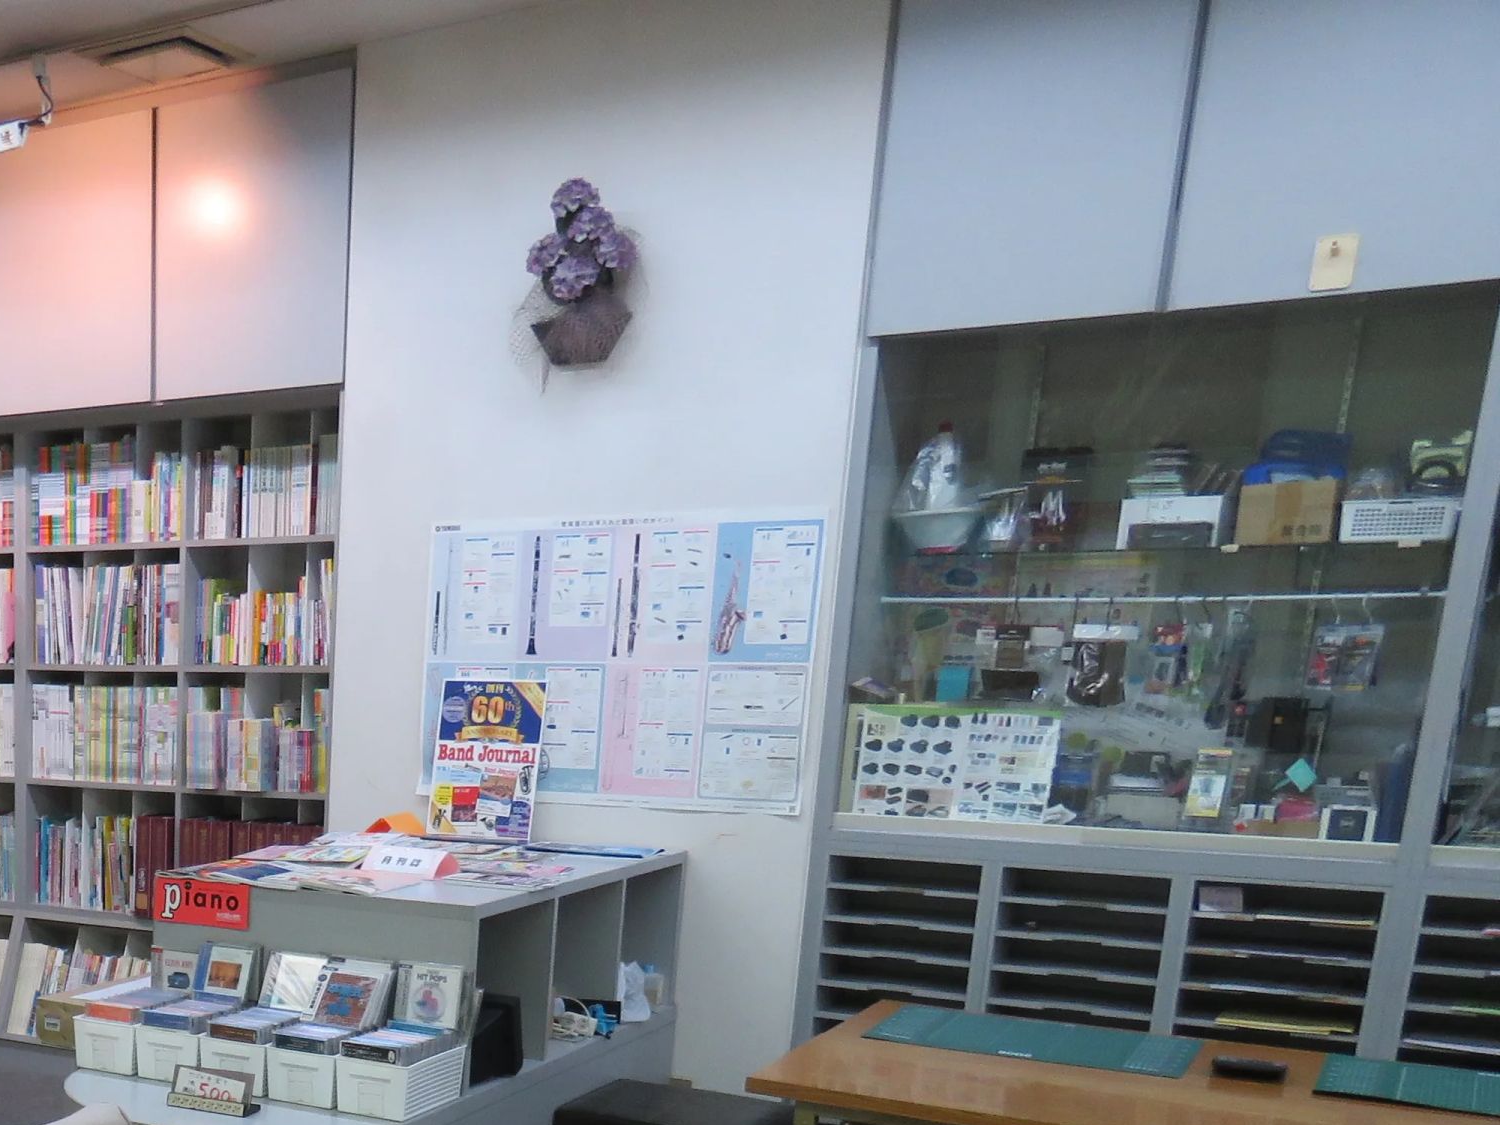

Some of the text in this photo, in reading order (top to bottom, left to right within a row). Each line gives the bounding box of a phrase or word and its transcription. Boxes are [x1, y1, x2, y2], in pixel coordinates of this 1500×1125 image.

[471, 695, 515, 724] 60th
[437, 744, 536, 764] Band Journal
[161, 881, 239, 919] piano
